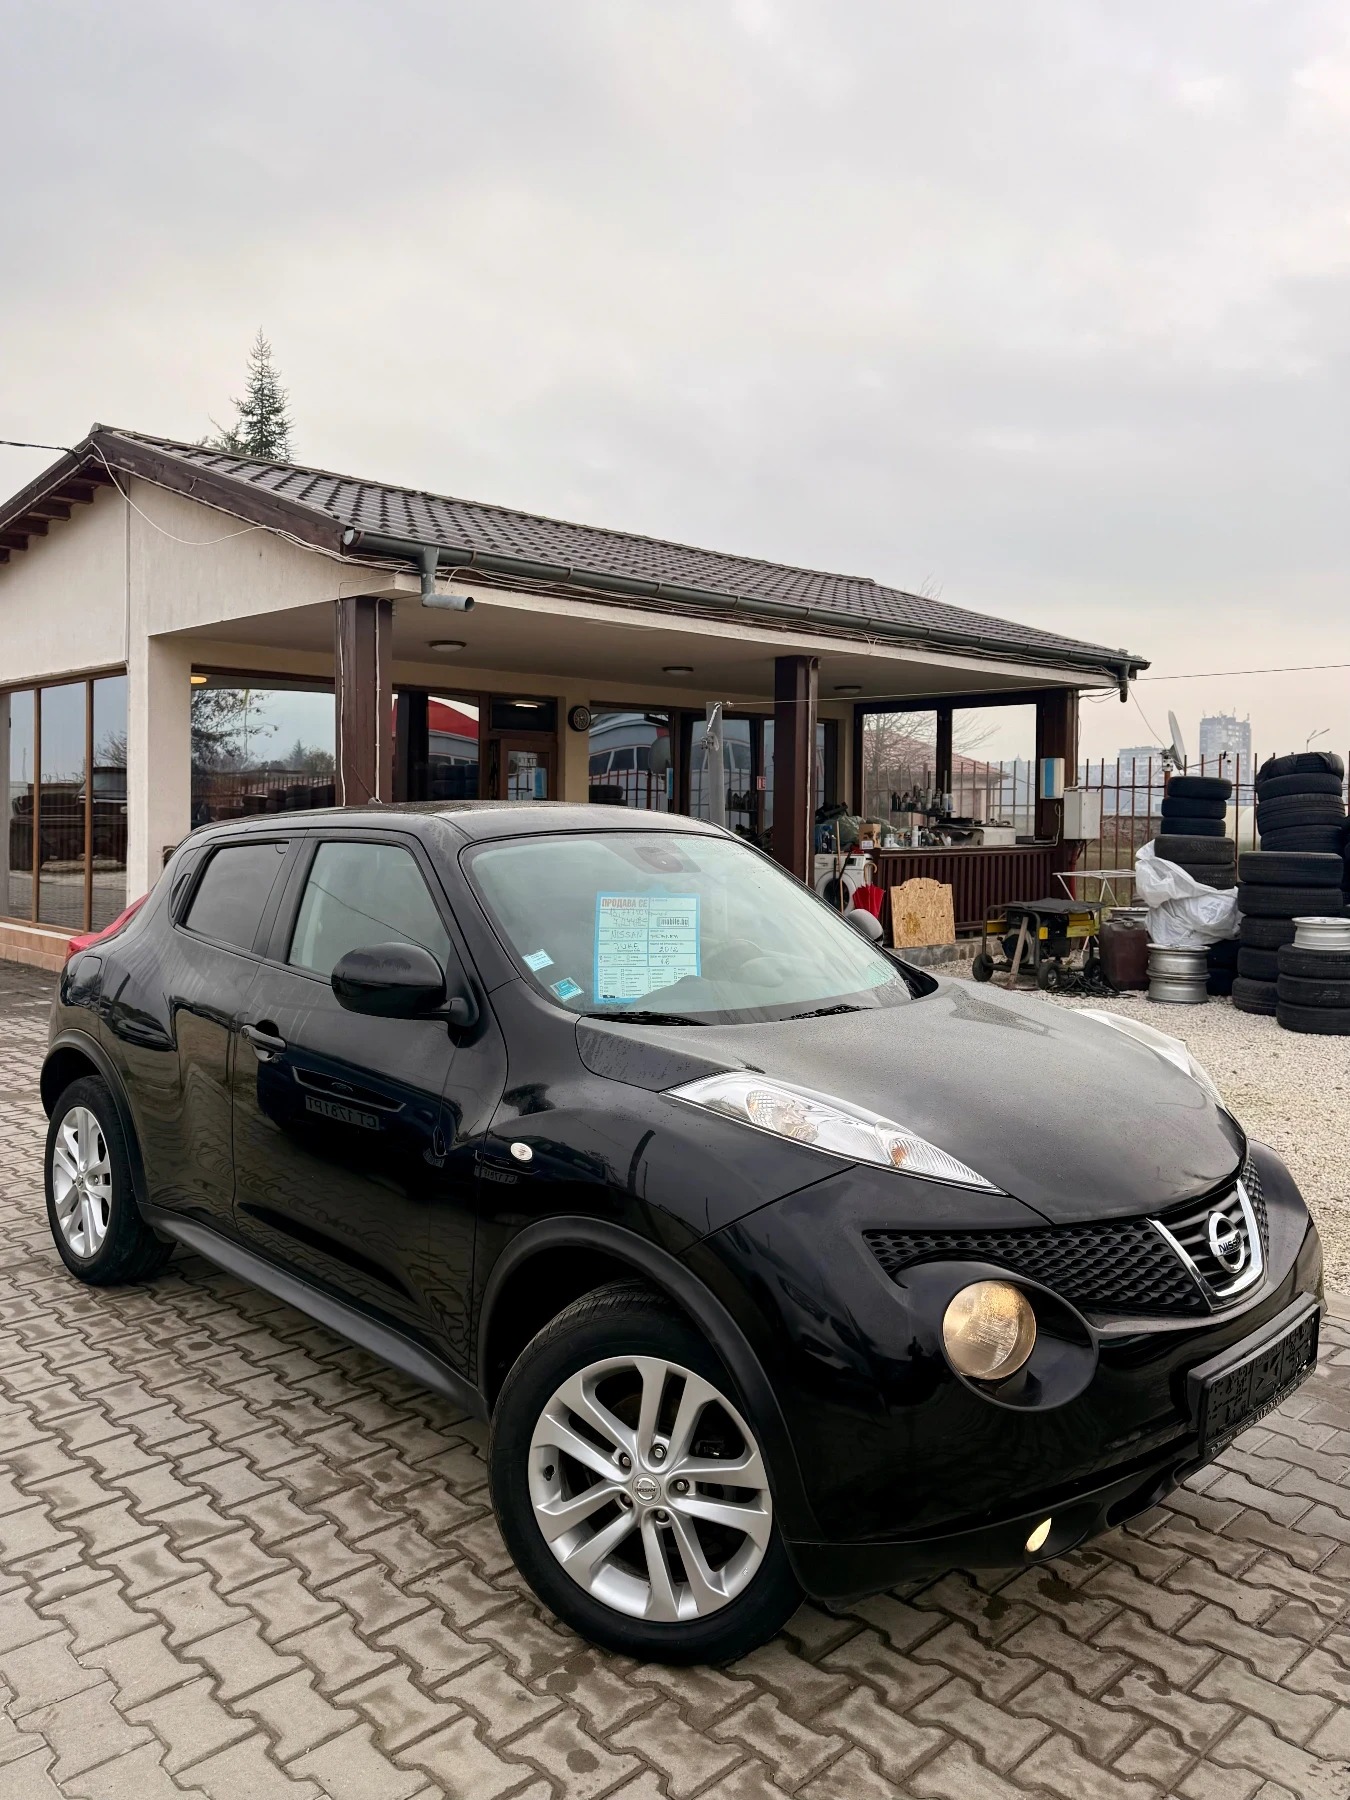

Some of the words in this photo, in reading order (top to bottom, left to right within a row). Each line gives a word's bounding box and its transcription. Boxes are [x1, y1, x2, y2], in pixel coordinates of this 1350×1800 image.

[602, 898, 637, 908] ПРОДАВА
[638, 899, 648, 908] СЕ
[610, 930, 643, 939] NISSAN
